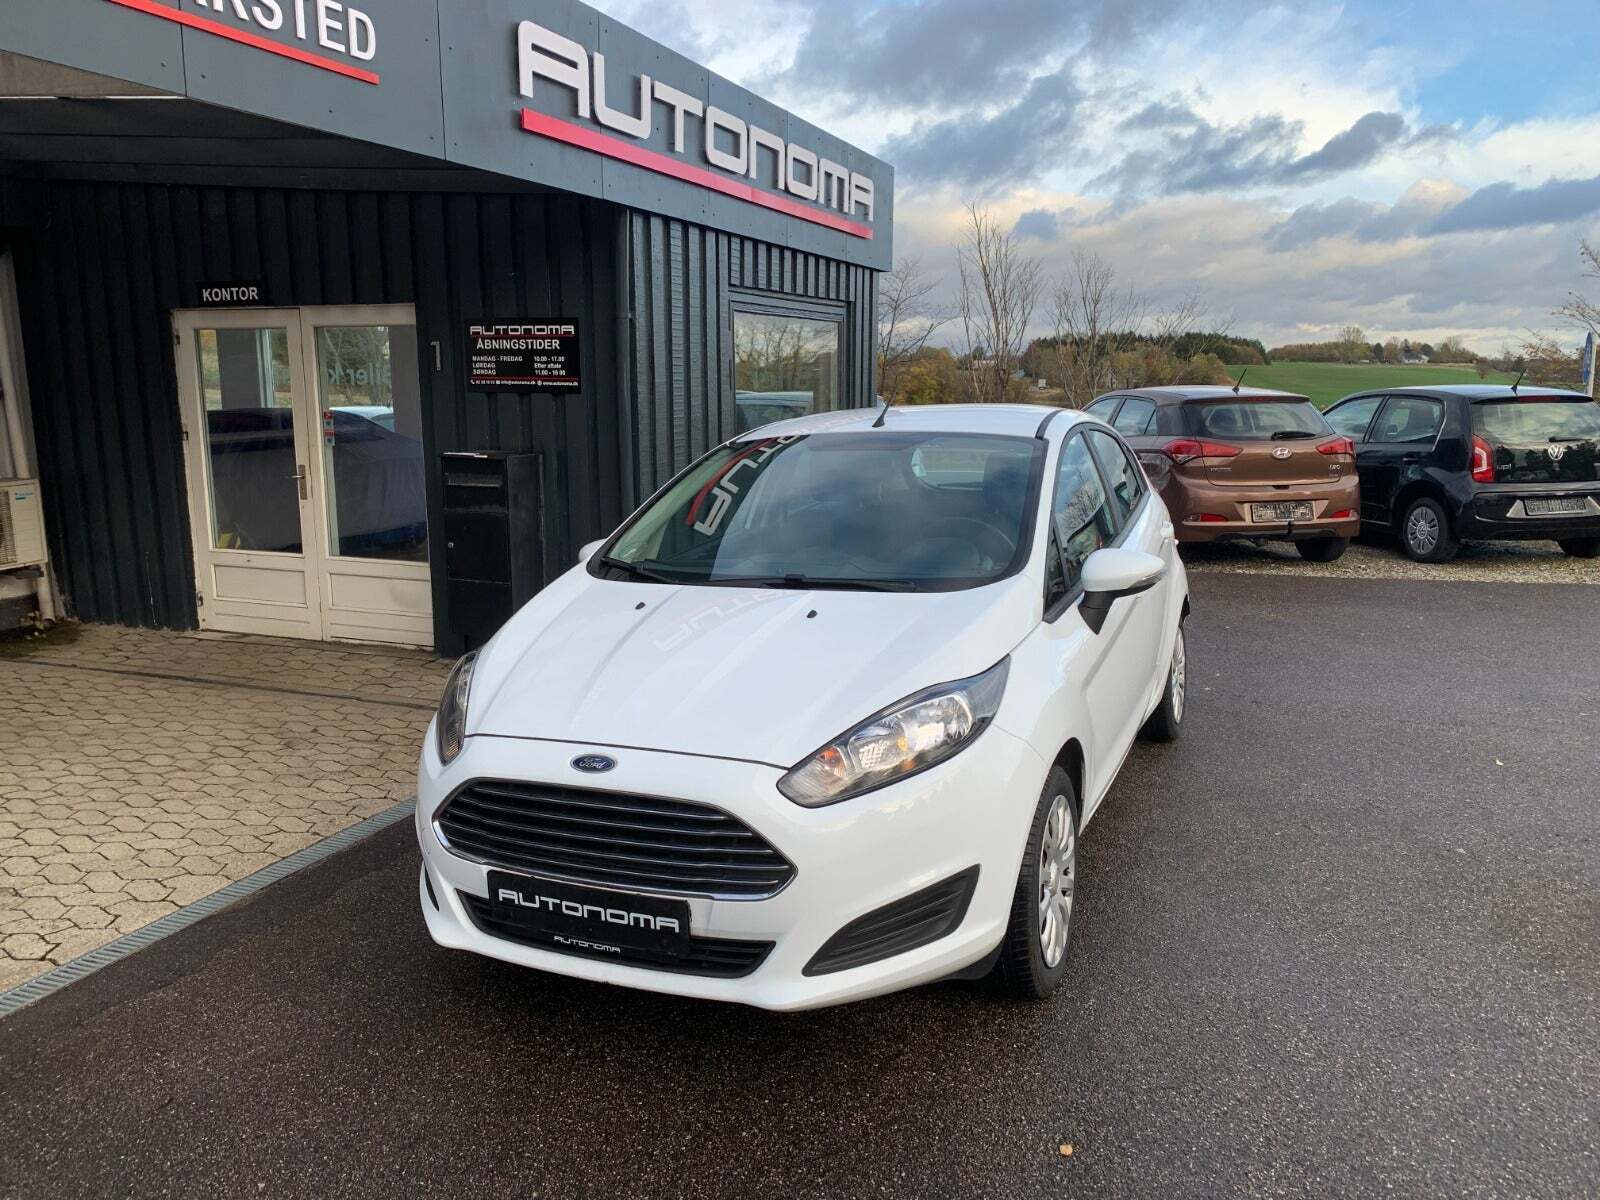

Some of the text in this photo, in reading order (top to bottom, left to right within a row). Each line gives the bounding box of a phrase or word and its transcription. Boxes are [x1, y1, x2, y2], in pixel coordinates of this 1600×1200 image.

[517, 20, 874, 222] AUTONOMA
[202, 286, 259, 302] KONTOR
[470, 325, 575, 335] AUTONOMA
[476, 338, 560, 350] ÅBNINGSTIDER
[498, 888, 680, 933] AUTONOMA
[554, 935, 621, 953] AUTONOMA
